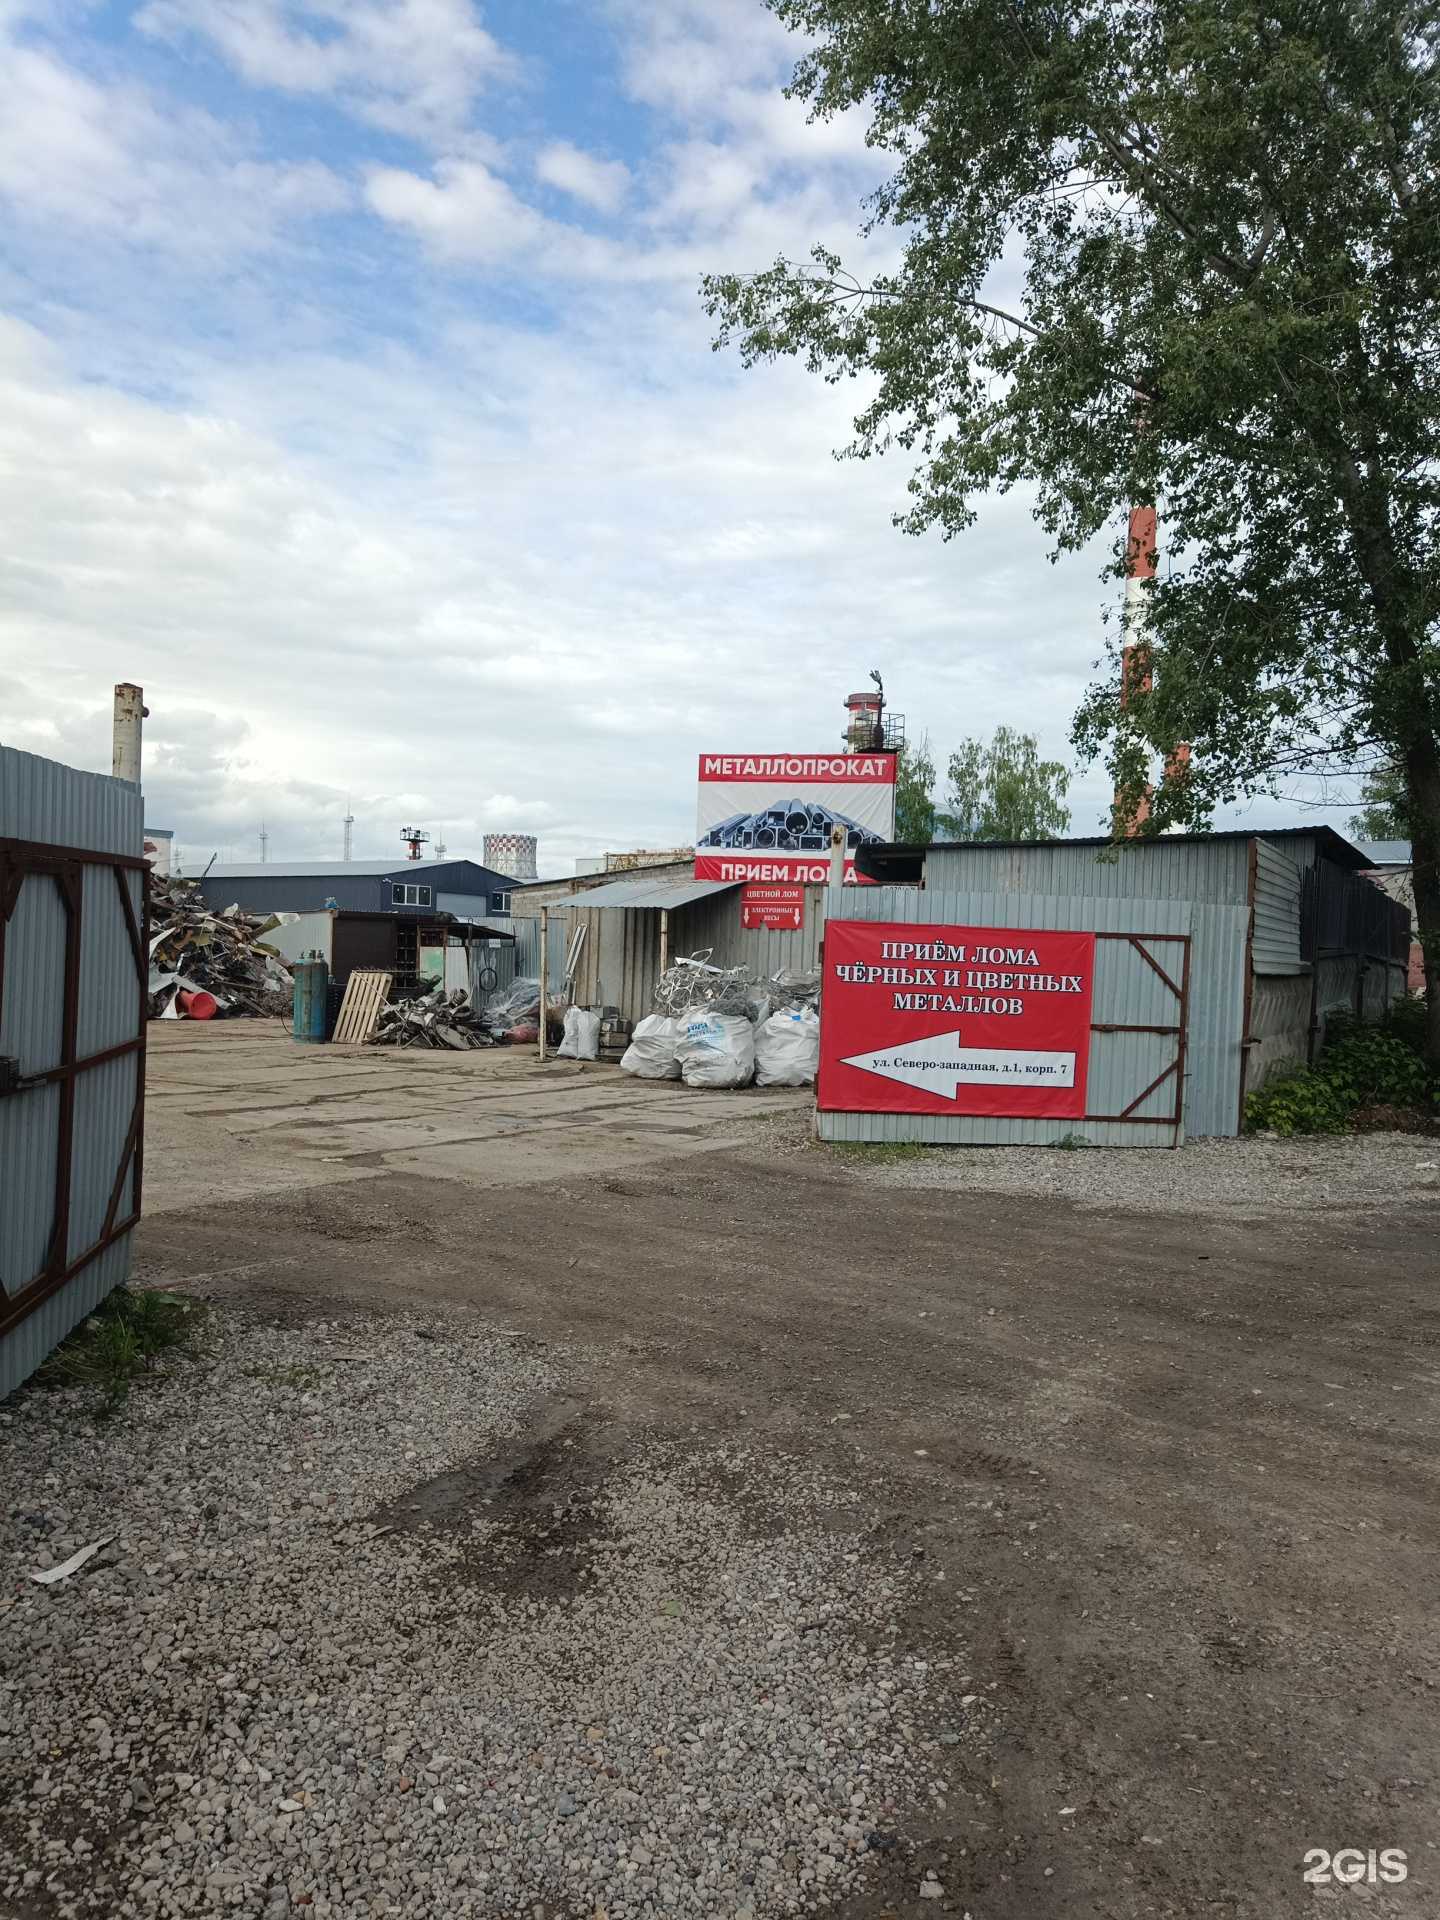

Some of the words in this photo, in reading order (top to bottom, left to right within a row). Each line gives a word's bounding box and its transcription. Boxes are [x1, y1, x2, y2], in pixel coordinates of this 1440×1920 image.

[704, 757, 887, 776] МЕТАЛЛОПРОКАТ
[720, 863, 789, 881] ПРИЕМ
[793, 866, 857, 882] ЛОА
[746, 890, 781, 898] ЦВЕТНОЙ
[781, 890, 799, 898] ЛОМ
[880, 940, 966, 962] ПРИЁМ
[971, 947, 1040, 966] ЛОМА
[835, 961, 937, 985] ЧЁРНЫХ
[943, 970, 960, 987] И
[966, 970, 1083, 993] ЦВЕТНЫХ
[893, 992, 1023, 1015] МЕТАЛЛОВ
[872, 1060, 890, 1069] ул.
[893, 1057, 999, 1073] Северо-западная,
[1025, 1065, 1057, 1075] корп.
[1060, 1064, 1067, 1074] 7
